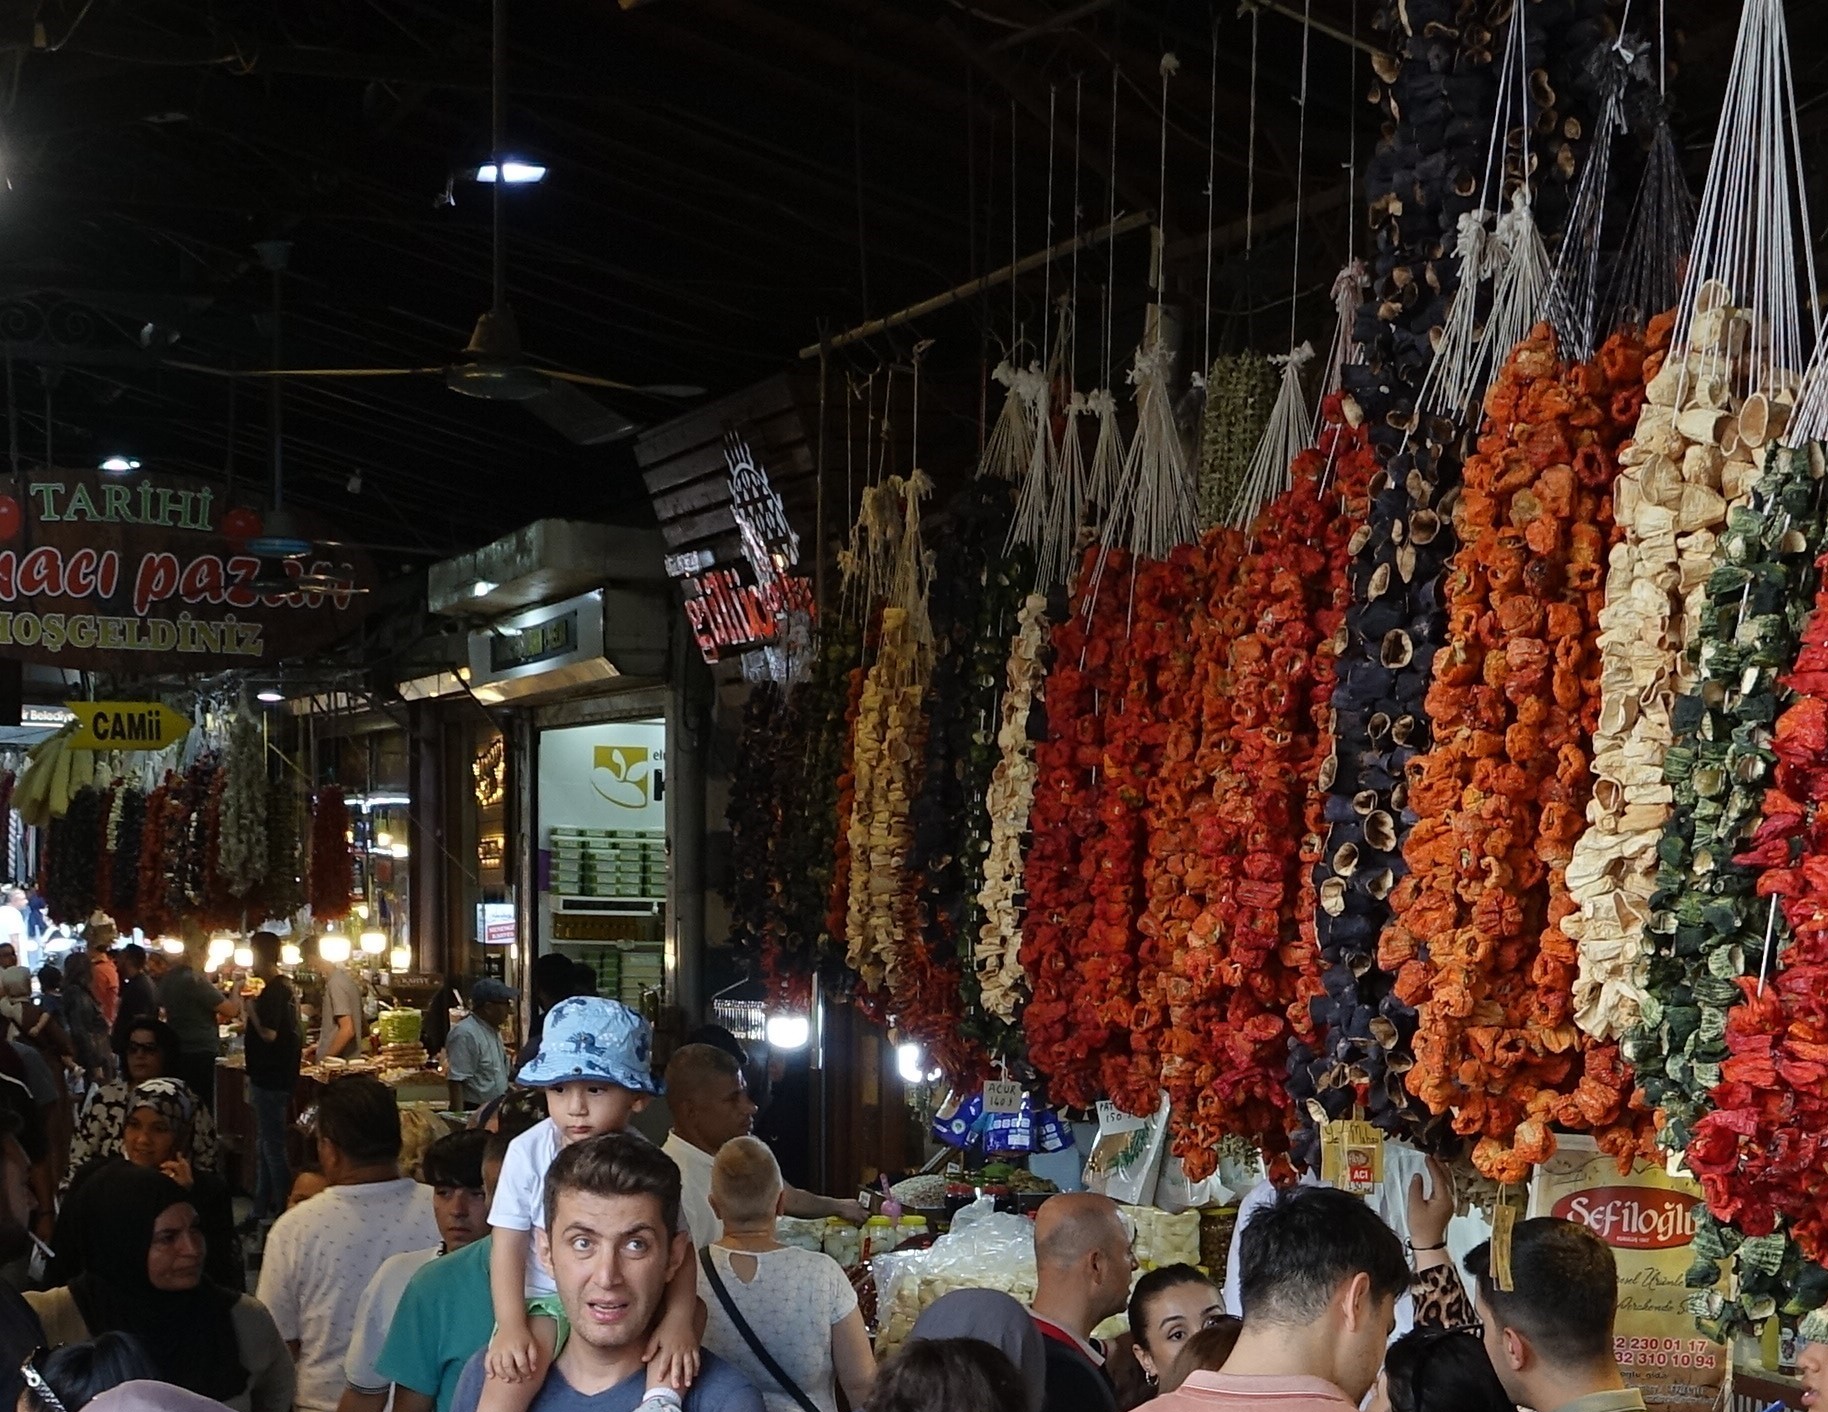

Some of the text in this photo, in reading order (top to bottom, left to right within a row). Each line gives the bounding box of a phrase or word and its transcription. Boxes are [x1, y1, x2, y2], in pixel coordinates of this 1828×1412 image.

[30, 480, 214, 531] TARİHİ
[1631, 1338, 1658, 1350] 230
[1663, 1339, 1680, 1351] 01
[1689, 1340, 1707, 1352] 17
[1638, 1352, 1666, 1365] 310
[1672, 1354, 1691, 1367] 10
[1695, 1354, 1714, 1369] 94
